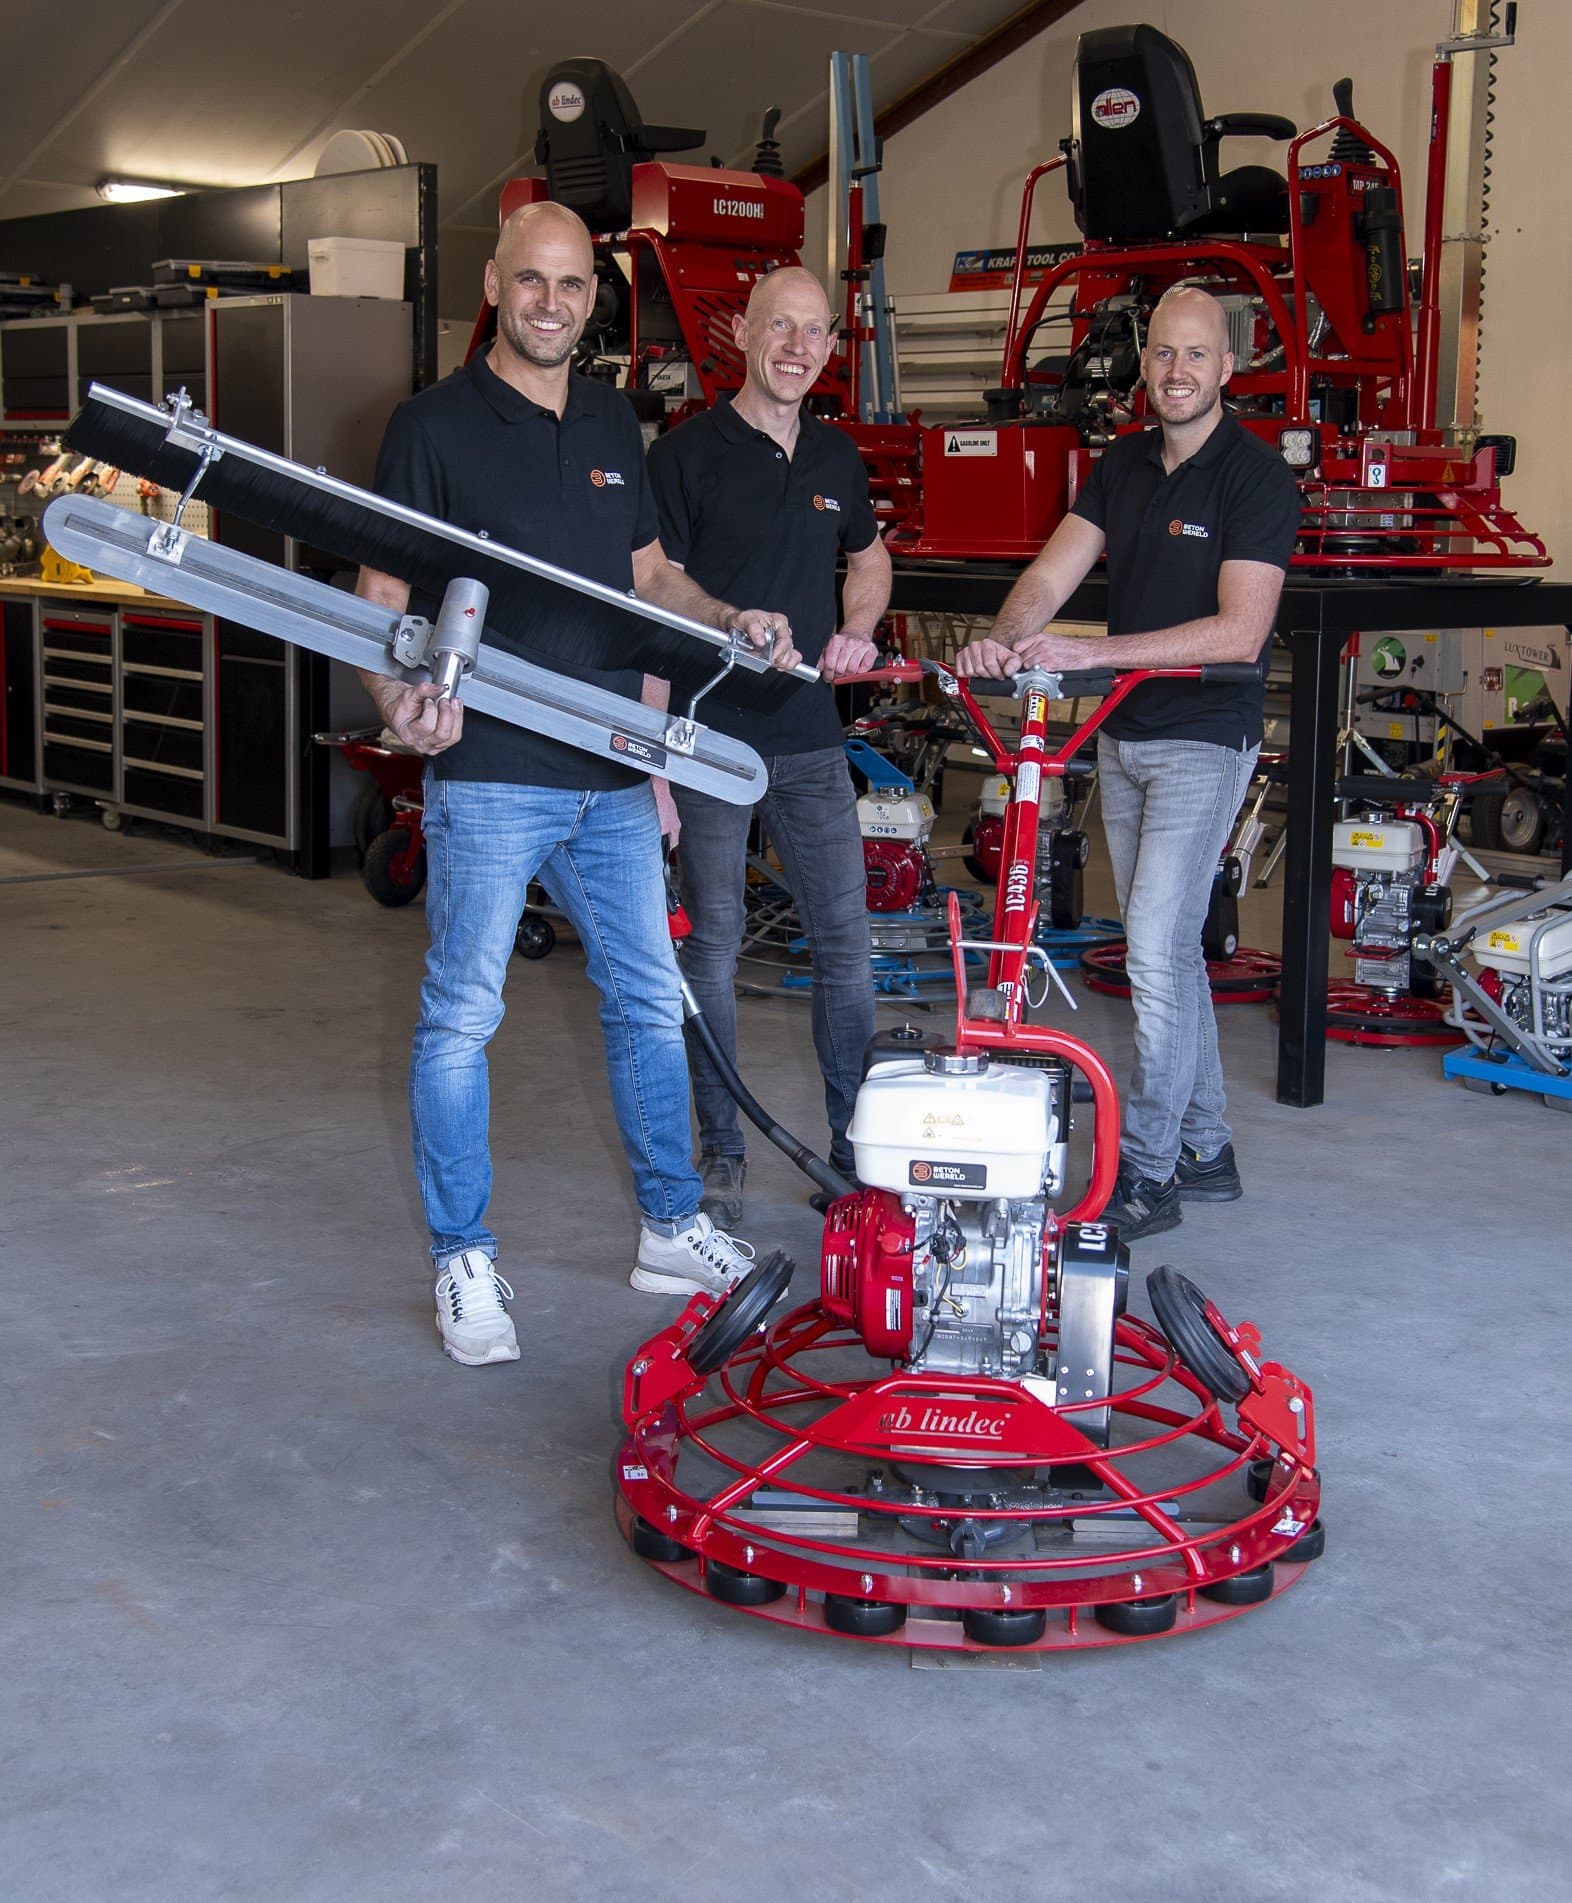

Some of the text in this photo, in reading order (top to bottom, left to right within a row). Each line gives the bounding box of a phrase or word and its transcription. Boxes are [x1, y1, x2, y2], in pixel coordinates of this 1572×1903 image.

[1095, 97, 1136, 117] allen
[1353, 179, 1364, 191] MP
[987, 256, 1017, 269] KRAF
[1027, 253, 1055, 266] TOOL
[933, 1166, 960, 1174] BETON
[933, 1172, 966, 1180] WERELD
[878, 1406, 1005, 1435] ab lindec
